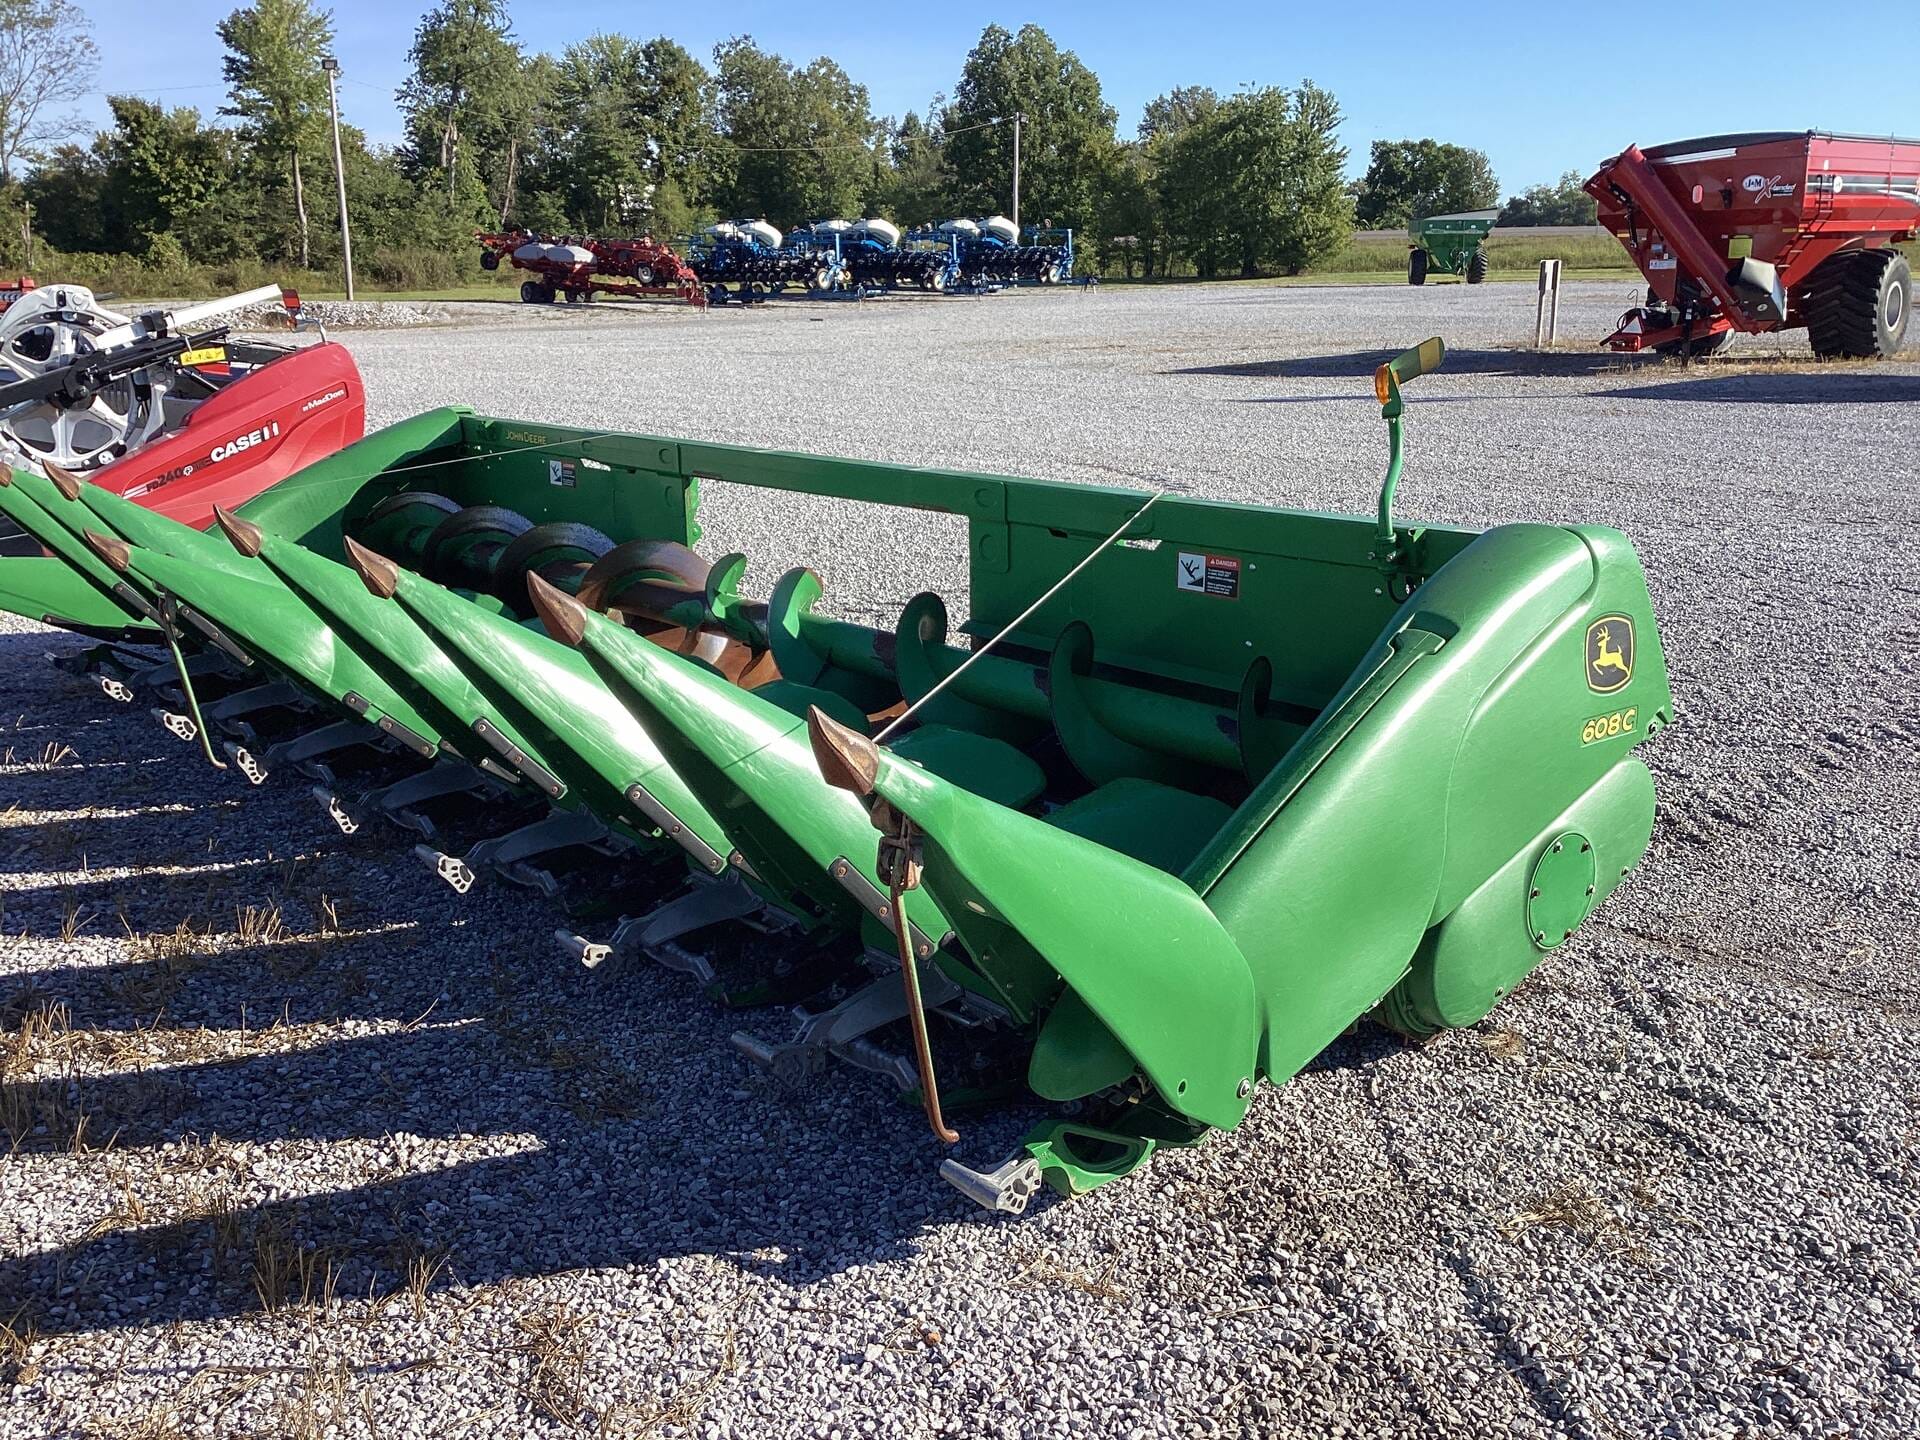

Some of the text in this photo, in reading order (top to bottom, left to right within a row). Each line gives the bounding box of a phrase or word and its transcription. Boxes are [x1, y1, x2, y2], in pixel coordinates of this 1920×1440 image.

[307, 389, 345, 409] MacDon
[210, 429, 262, 462] CASE
[506, 430, 547, 444] JOHN DEERE
[1215, 559, 1237, 568] DANGER
[1582, 707, 1637, 744] 608C
